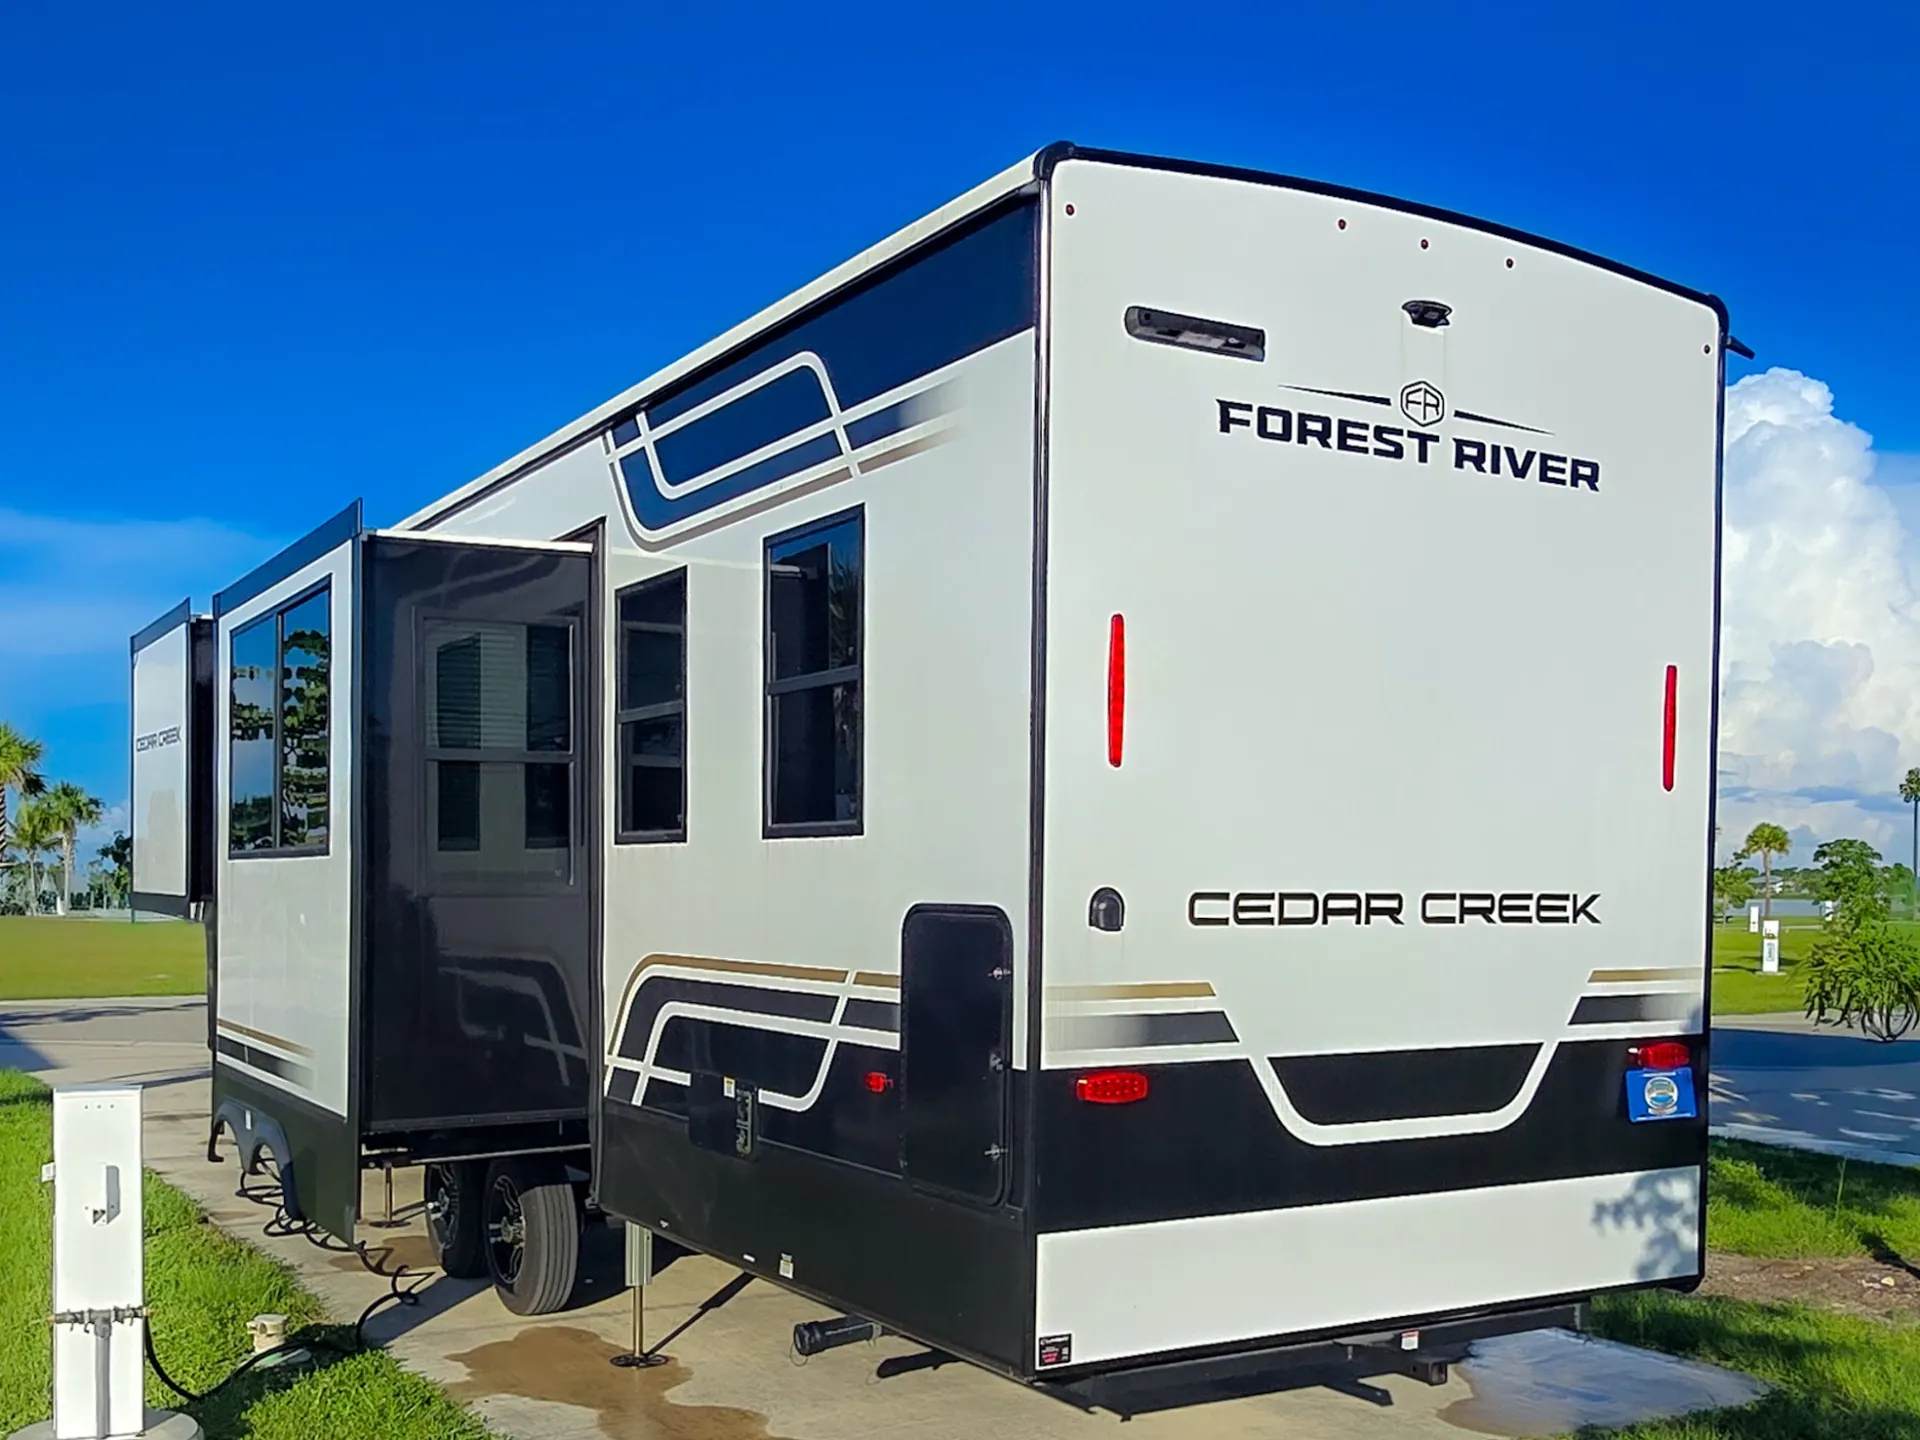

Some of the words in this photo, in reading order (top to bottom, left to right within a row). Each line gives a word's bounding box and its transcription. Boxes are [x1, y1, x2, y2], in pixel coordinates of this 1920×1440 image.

[1215, 398, 1440, 464] FOREST
[1452, 437, 1601, 493] RIVER
[1188, 891, 1405, 926] CEDAR
[1420, 892, 1602, 925] CREEK
